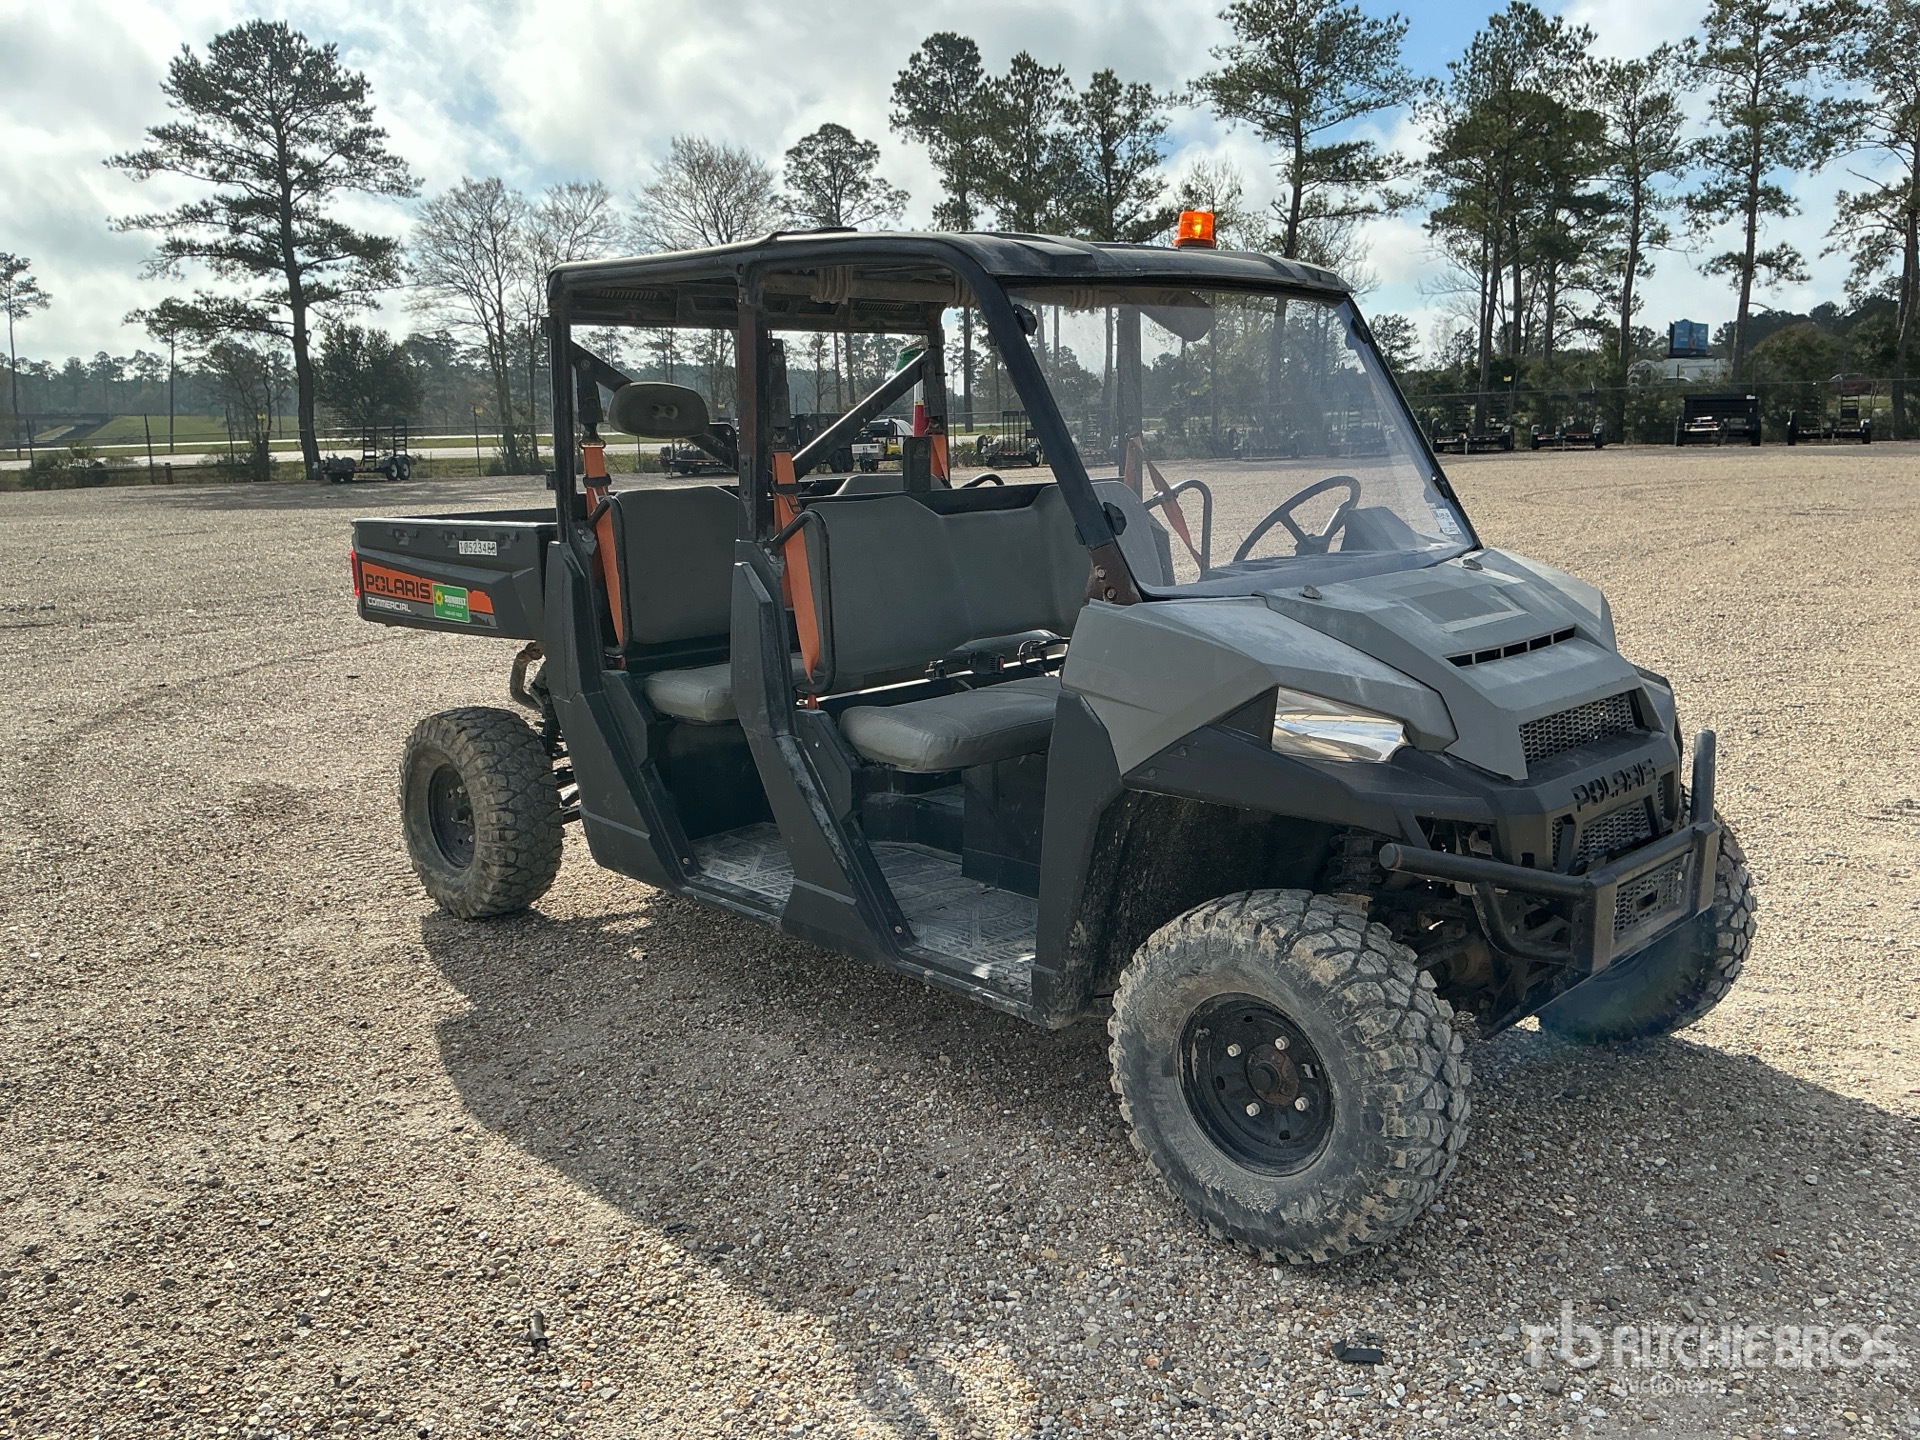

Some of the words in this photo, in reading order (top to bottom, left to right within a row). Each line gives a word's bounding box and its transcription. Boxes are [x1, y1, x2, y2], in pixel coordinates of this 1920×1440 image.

[365, 573, 431, 600] POLARIS
[367, 596, 412, 613] COMMERCIAL
[1571, 758, 1657, 813] POLARIS
